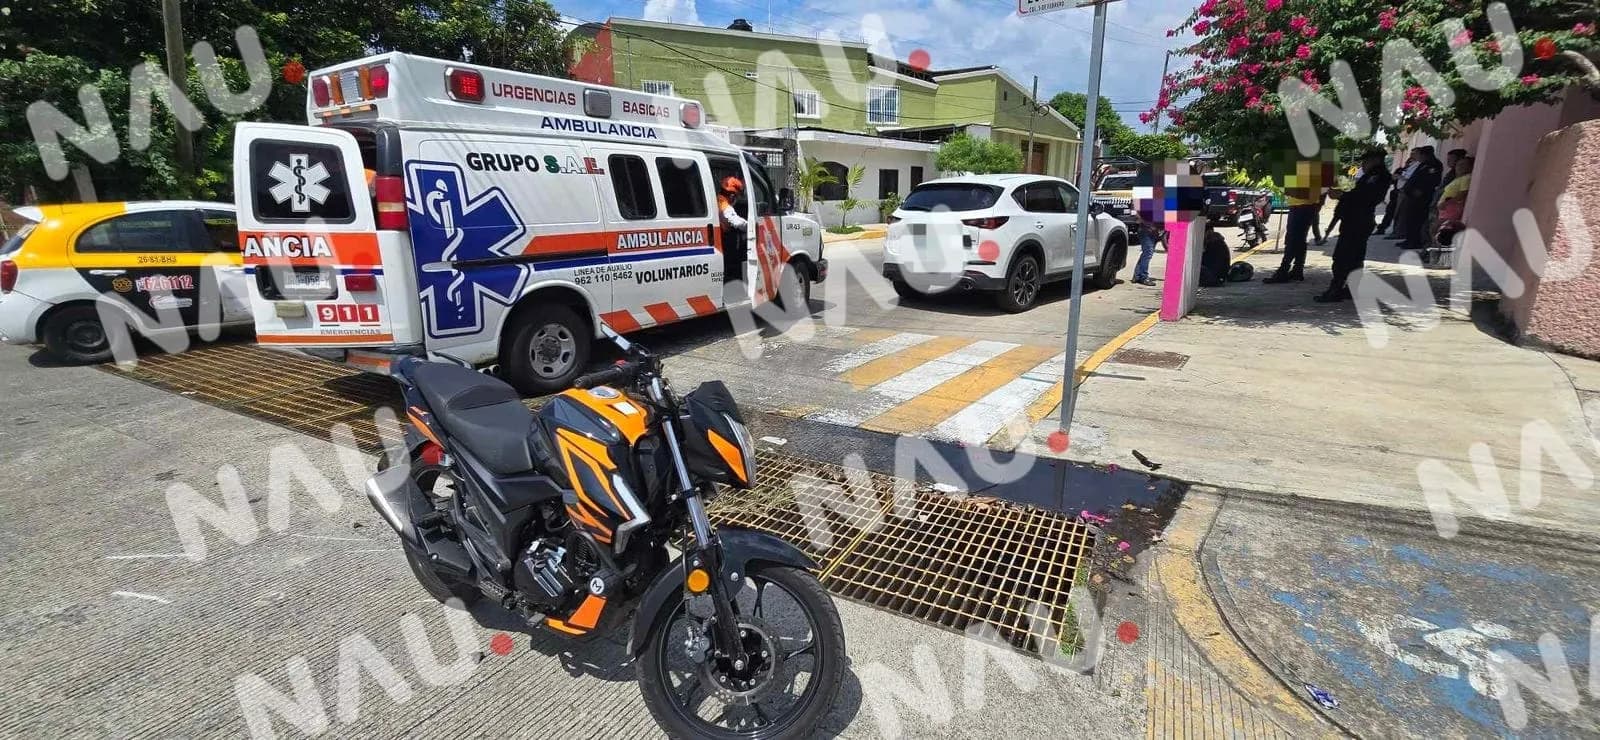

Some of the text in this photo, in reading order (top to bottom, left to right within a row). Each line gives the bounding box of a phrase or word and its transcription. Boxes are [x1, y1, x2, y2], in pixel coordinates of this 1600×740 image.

[492, 82, 670, 118] URGENCIAS BASICAS
[541, 116, 658, 139] AMBULANCIA
[466, 152, 606, 175] GRUPO S.A.E.
[244, 235, 332, 258] ANCIA
[617, 230, 704, 249] AMBULANCIA
[574, 264, 633, 276] LINEA DE AUXILIO
[575, 270, 633, 285] 962 110 5462
[635, 263, 709, 284] VOLUNTARIOS
[319, 305, 377, 322] 911
